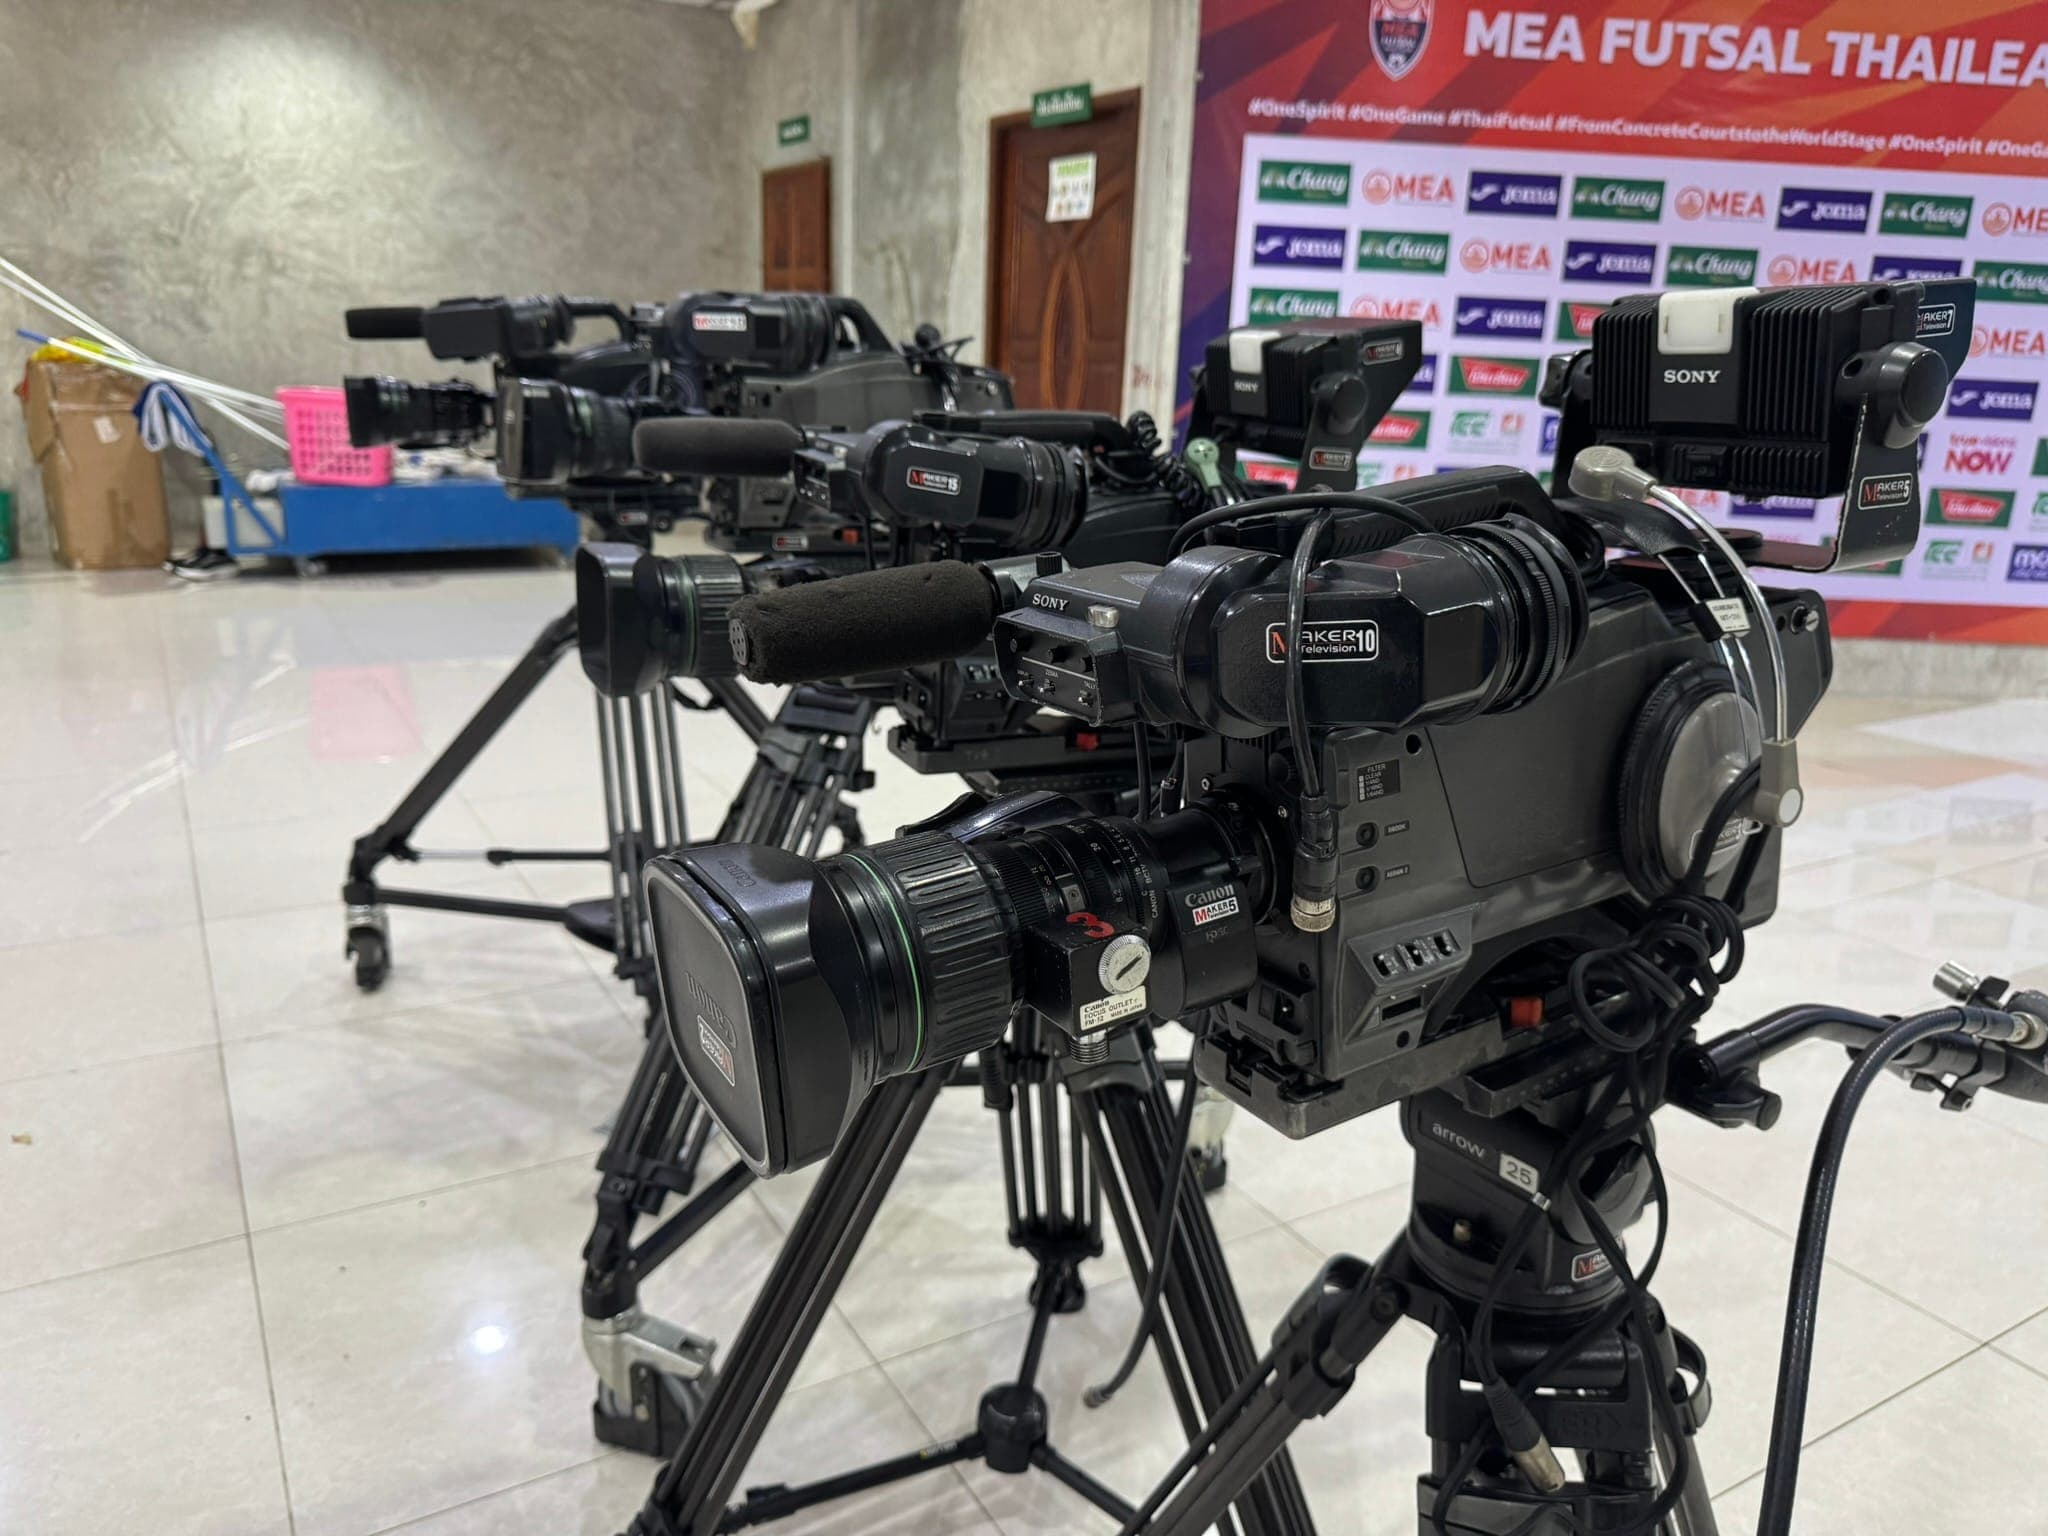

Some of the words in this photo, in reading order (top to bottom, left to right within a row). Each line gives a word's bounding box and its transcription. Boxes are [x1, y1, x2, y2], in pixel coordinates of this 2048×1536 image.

[1464, 10, 1586, 62] MEA
[1600, 18, 1811, 75] FUTSAL
[1249, 97, 1345, 122] #OneSpirit
[1348, 103, 1446, 127] #OneGame
[1448, 108, 1553, 133] #ThaiFutsal
[1889, 134, 1982, 159] #OneSpirit
[1286, 165, 1348, 196] Chang
[1393, 175, 1455, 202] MEA
[1501, 183, 1559, 206] joma
[1603, 182, 1660, 214] Chang
[1704, 191, 1765, 218] MEA
[1811, 200, 1867, 222] joma
[1909, 200, 1968, 230] Chang
[1286, 235, 1343, 260] joma
[1387, 233, 1447, 265] Chang
[1490, 243, 1551, 272] MEA
[1598, 251, 1652, 277] joma
[1694, 251, 1755, 280] Chang
[1801, 258, 1856, 284] MEA
[1486, 309, 1543, 332] joma
[1990, 329, 2045, 356] MEA
[1234, 380, 1259, 393] SONY
[1663, 368, 1722, 385] SONY
[1944, 450, 2013, 474] NOW
[1032, 593, 1068, 612] SONY
[1300, 643, 1357, 655] Television
[1367, 763, 1386, 773] FILTER
[1150, 889, 1159, 919] CANON
[1184, 884, 1235, 907] Canon
[1066, 911, 1116, 939] 3
[1084, 1007, 1106, 1020] FOCUS
[1108, 998, 1133, 1012] OUTLET
[1432, 1122, 1485, 1158] arrow
[1505, 1160, 1532, 1185] 25
